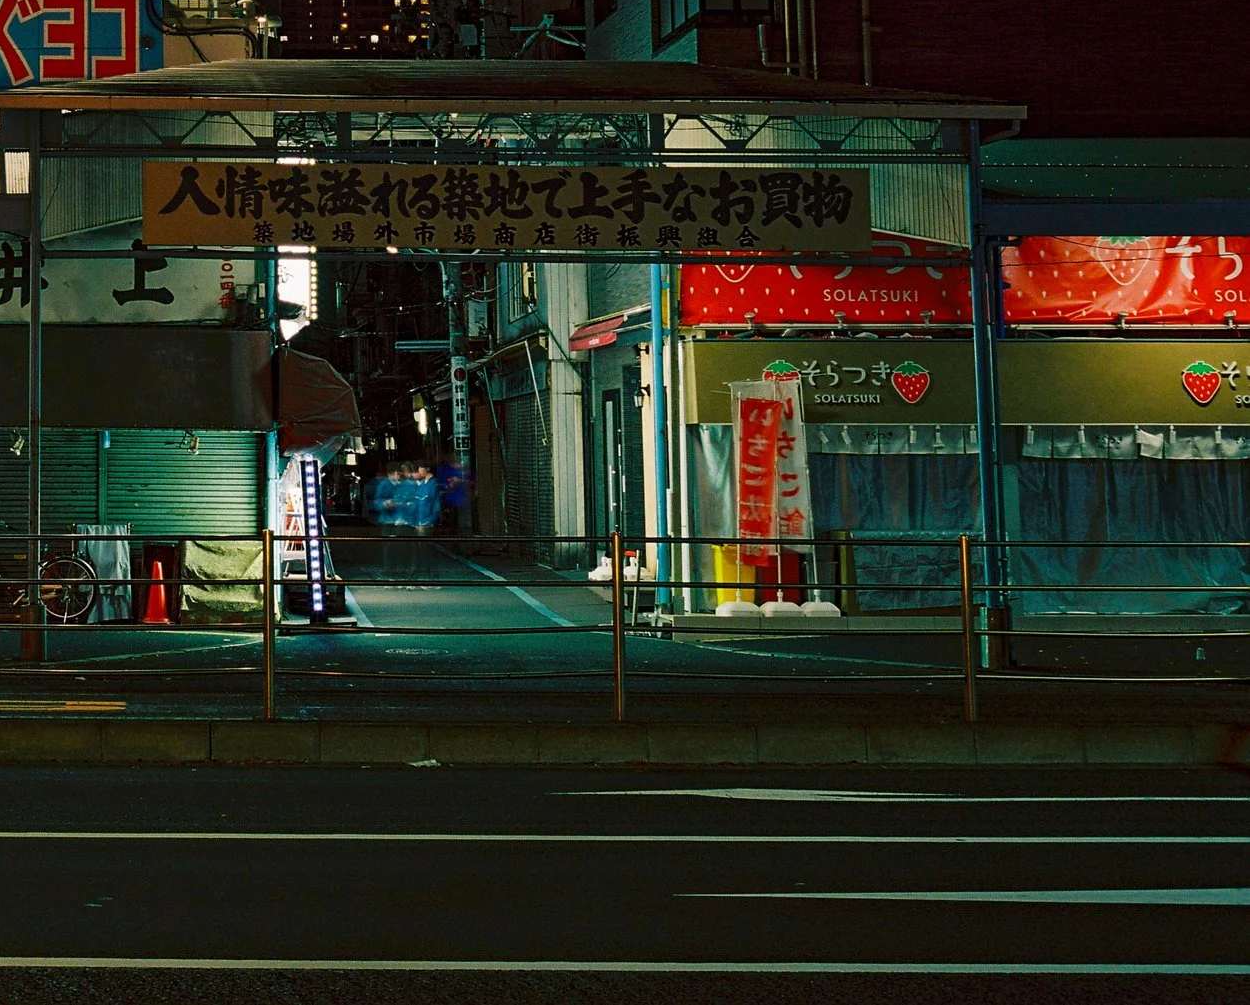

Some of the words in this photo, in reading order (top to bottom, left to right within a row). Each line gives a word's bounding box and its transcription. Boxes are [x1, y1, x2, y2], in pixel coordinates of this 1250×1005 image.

[158, 164, 853, 228] 人情味溢れる築地で上手なお買物
[252, 221, 761, 248] 築地場外市場商店街振興組合
[823, 288, 919, 303] SOLATSUKI
[1214, 289, 1250, 303] SOL
[801, 360, 892, 387] そらつき
[814, 393, 881, 404] SOLATSUKI
